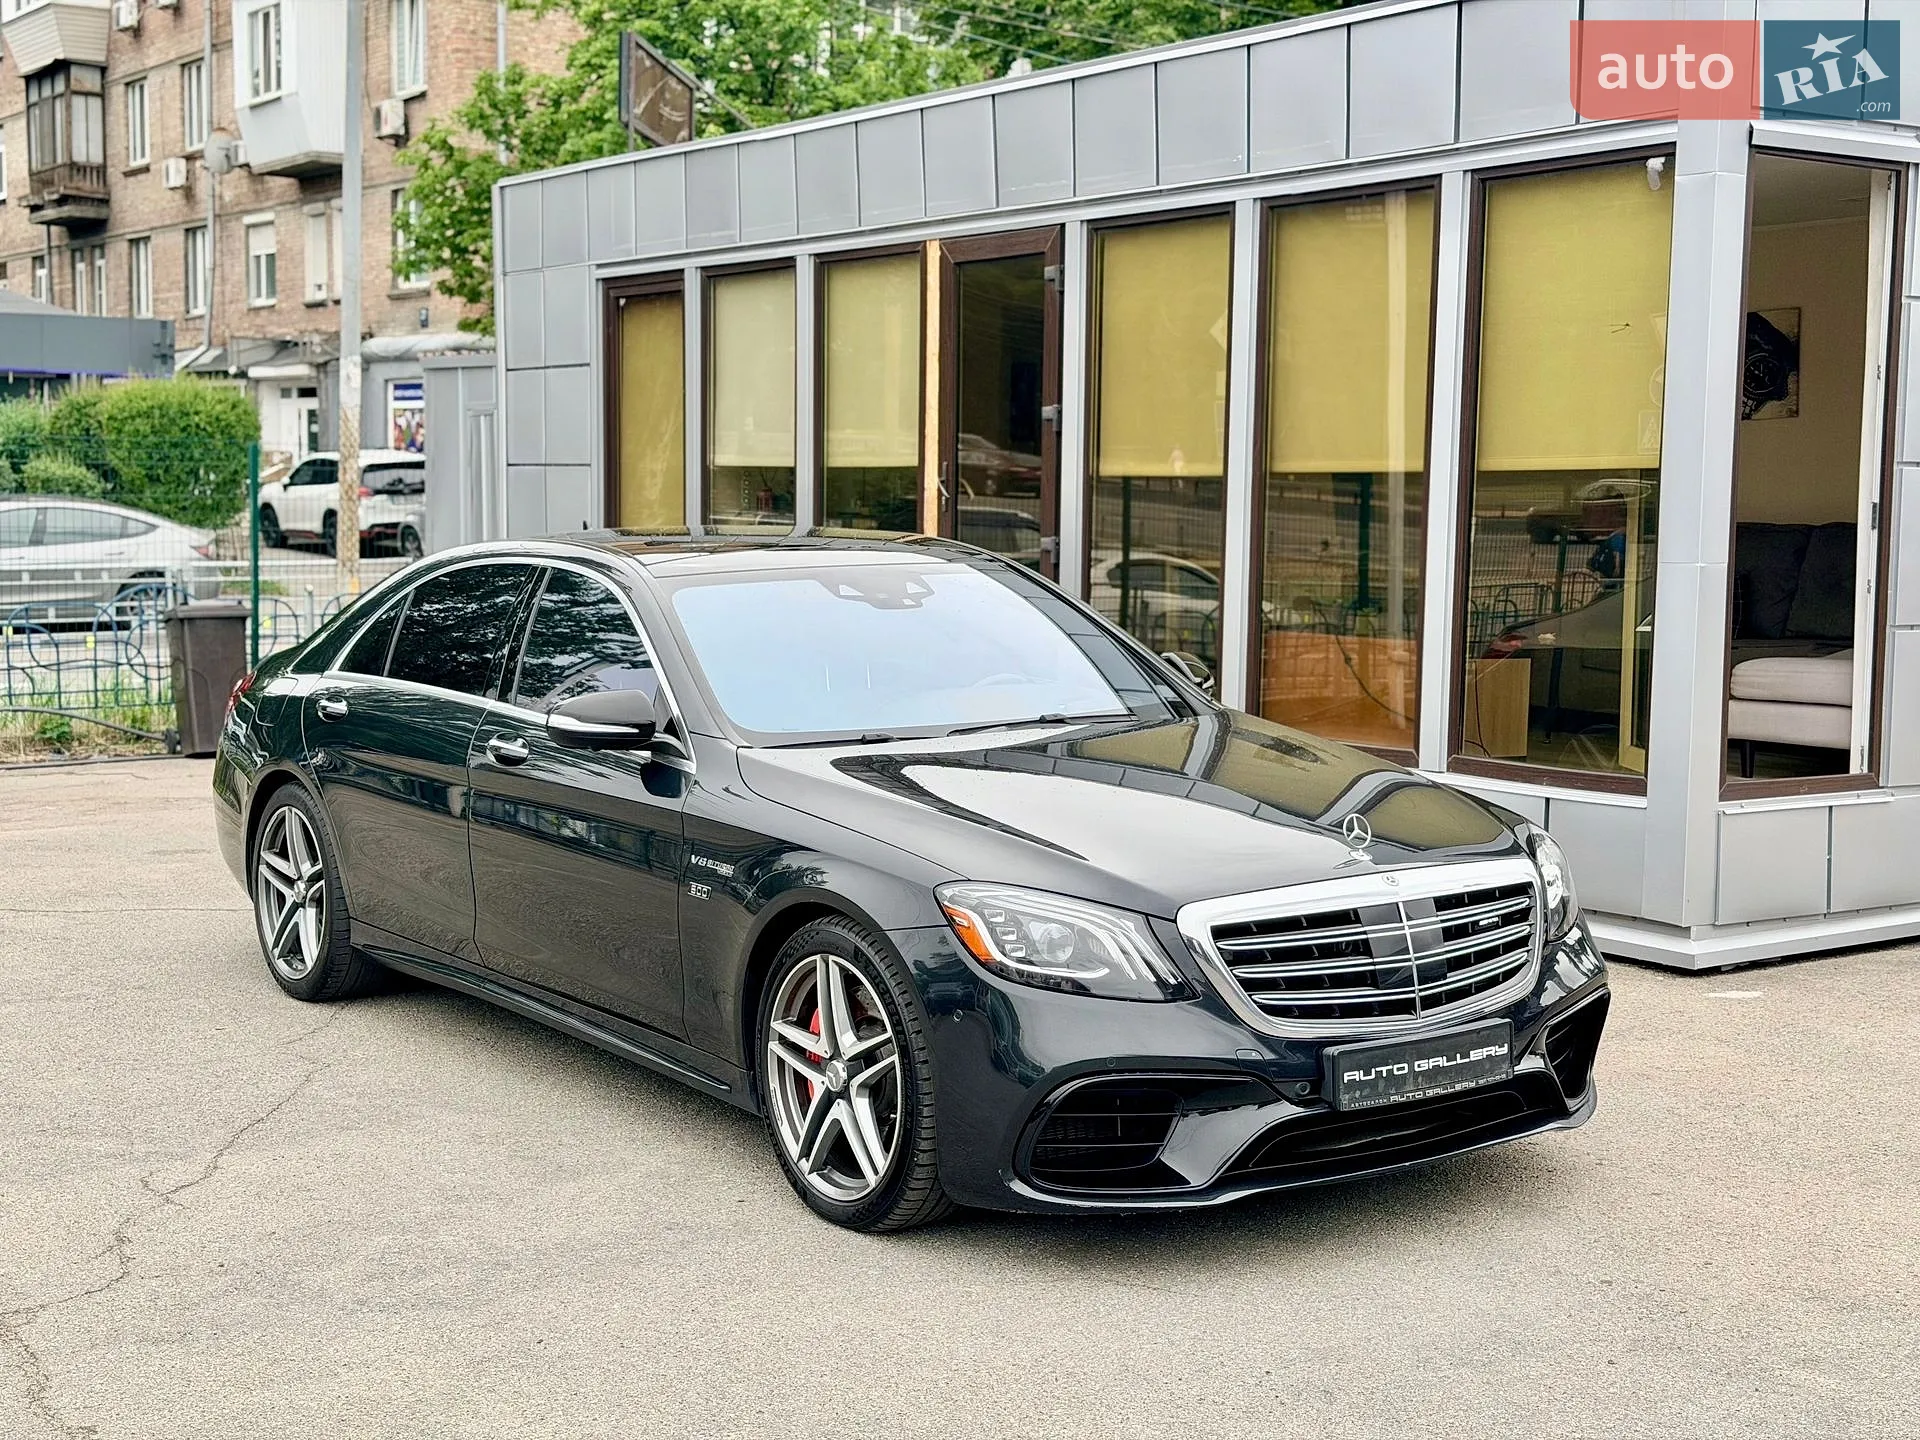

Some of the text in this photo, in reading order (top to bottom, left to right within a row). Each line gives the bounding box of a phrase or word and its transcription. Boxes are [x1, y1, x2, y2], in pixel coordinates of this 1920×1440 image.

[691, 854, 707, 866] V8
[1343, 1043, 1508, 1083] AUTO GALLERY
[1390, 1091, 1423, 1103] AUTO
[1425, 1079, 1476, 1097] GALLERY
